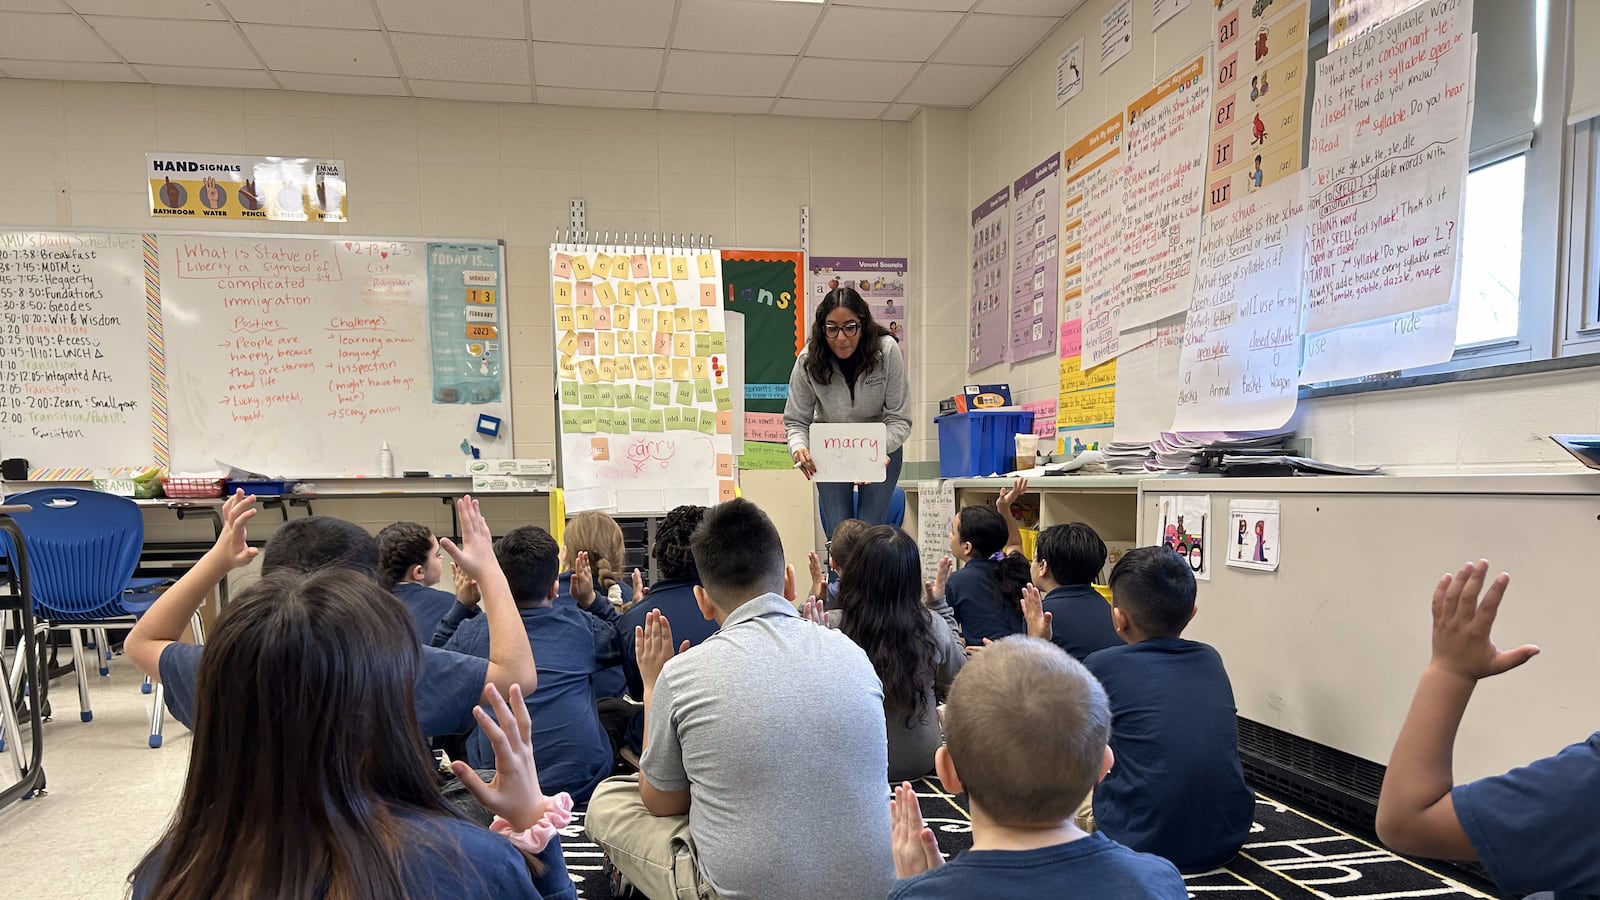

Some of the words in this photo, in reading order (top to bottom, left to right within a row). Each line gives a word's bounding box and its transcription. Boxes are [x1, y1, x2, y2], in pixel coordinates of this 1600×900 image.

[1220, 18, 1237, 43] ar
[1319, 62, 1335, 77] How
[1339, 55, 1348, 67] to
[1352, 36, 1376, 60] READ
[1378, 30, 1383, 45] 2
[1387, 10, 1425, 41] syllable
[1329, 69, 1346, 88] that
[1350, 60, 1363, 78] end
[1366, 58, 1374, 68] in
[1378, 27, 1429, 64] consonant
[1219, 60, 1236, 84] or
[1339, 85, 1355, 100] the
[1360, 70, 1384, 92] first
[1388, 49, 1426, 83] syllable
[1429, 39, 1451, 60] open
[1354, 96, 1370, 111] How
[1373, 89, 1385, 102] do
[1390, 82, 1404, 98] you
[1217, 102, 1234, 125] er
[1318, 135, 1339, 156] Read
[1410, 99, 1422, 114] Do
[1426, 93, 1441, 113] you
[1444, 82, 1465, 98] hear
[1216, 144, 1230, 166] ir
[153, 160, 199, 173] HAND
[199, 163, 241, 173] SIGNALS
[1368, 161, 1397, 184] syllable
[1400, 154, 1423, 173] words
[1426, 146, 1446, 161] with
[1211, 184, 1230, 205] ur
[153, 208, 195, 216] BATHROOM
[203, 210, 227, 218] WATER
[1266, 211, 1280, 228] the
[1281, 200, 1305, 221] schwa
[1210, 216, 1228, 233] hear
[1311, 215, 1338, 237] CHUNK
[1340, 208, 1357, 226] word
[1331, 228, 1352, 248] SPELL
[1354, 225, 1369, 237] first
[1400, 198, 1424, 218] Think
[39, 234, 71, 257] Daily
[1412, 233, 1428, 247] hear
[185, 243, 230, 260] What
[235, 248, 250, 260] is
[305, 249, 320, 263] of
[431, 252, 468, 266] TODAY
[187, 261, 231, 277] Liberty
[239, 265, 250, 273] a
[263, 262, 312, 278] symbol
[317, 260, 329, 273] of
[577, 263, 585, 271] b
[617, 262, 624, 270] d
[677, 264, 683, 274] g
[1309, 284, 1334, 299] ALWAYS
[1355, 268, 1380, 284] because
[1381, 262, 1401, 277] every
[1403, 250, 1430, 272] syllable
[1415, 264, 1441, 284] maple
[217, 276, 306, 292] complicated
[817, 285, 824, 293] a
[223, 294, 311, 313] immigration
[471, 290, 477, 302] 1
[484, 291, 491, 303] 3
[469, 310, 494, 319] FEBRUARY
[1259, 299, 1274, 314] use
[80, 313, 121, 326] Wisdom
[234, 315, 280, 329] Positives
[1393, 311, 1421, 334] rude
[473, 327, 489, 336] 2023
[235, 336, 275, 350] People
[278, 335, 299, 345] are
[339, 333, 383, 349] learning
[1308, 337, 1327, 357] use
[55, 348, 91, 359] LUNCH
[277, 348, 313, 357] because
[338, 348, 382, 362] language
[92, 369, 113, 382] Arts
[229, 366, 256, 385] they
[258, 366, 280, 376] are
[337, 360, 398, 377] inspection
[260, 376, 276, 388] life
[367, 378, 388, 388] have
[403, 377, 416, 392] go
[637, 394, 649, 402] ing
[824, 436, 879, 462] marry
